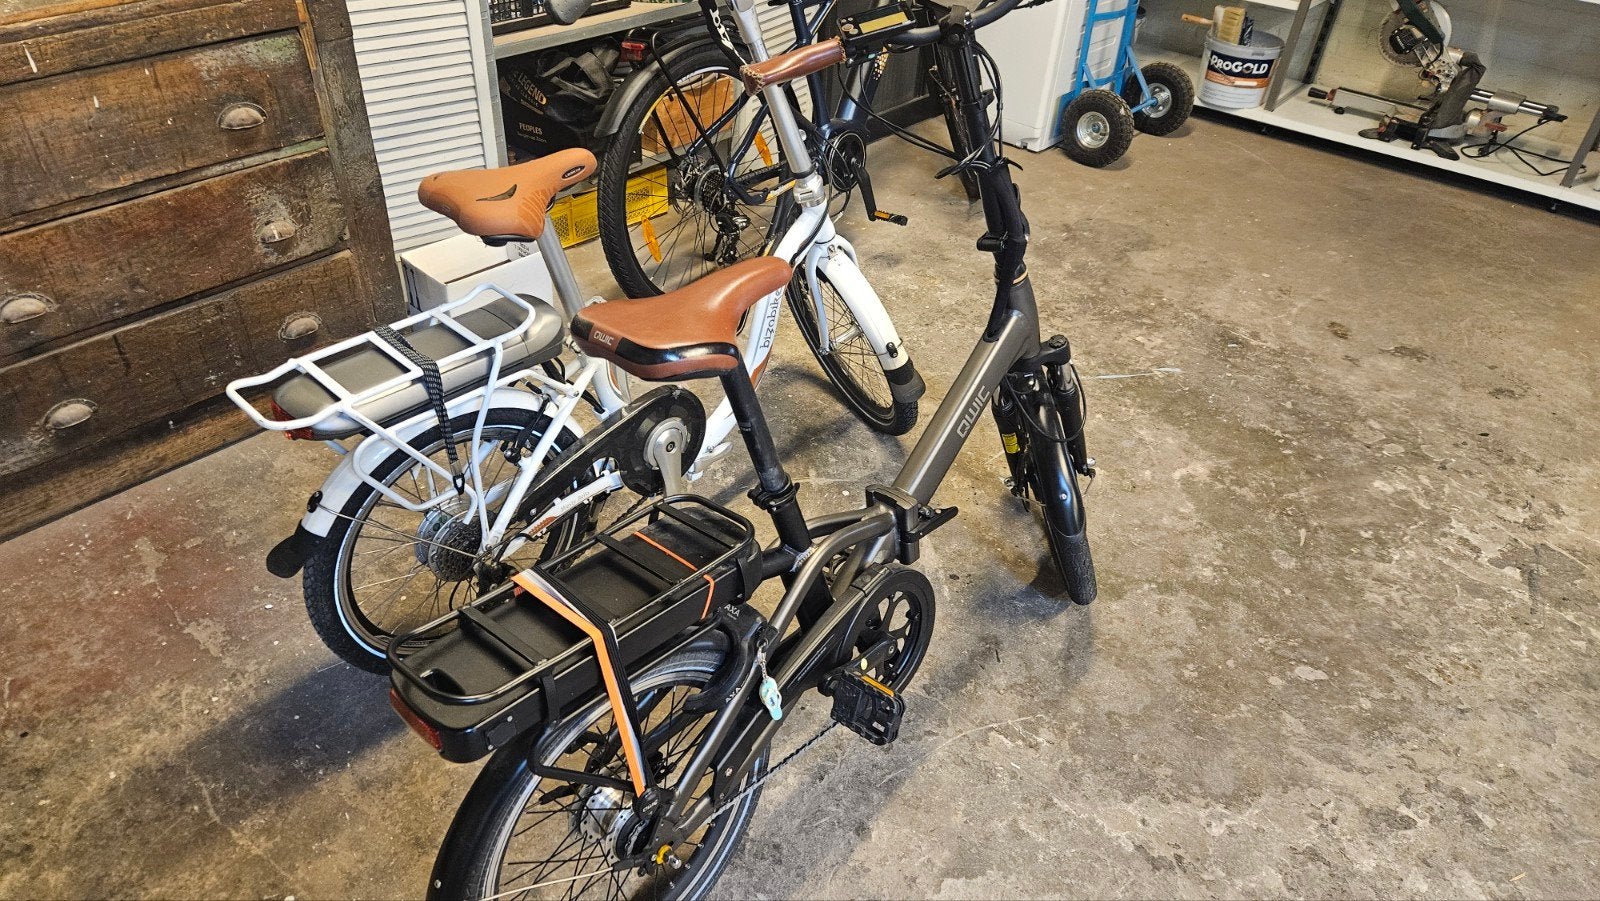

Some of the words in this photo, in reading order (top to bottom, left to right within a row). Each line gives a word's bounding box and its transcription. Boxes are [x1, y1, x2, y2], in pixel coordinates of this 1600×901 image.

[517, 73, 548, 105] LEGEND
[593, 330, 614, 347] QWIC
[956, 385, 991, 439] QWIC
[724, 603, 741, 616] AXA
[725, 687, 742, 703] AXA
